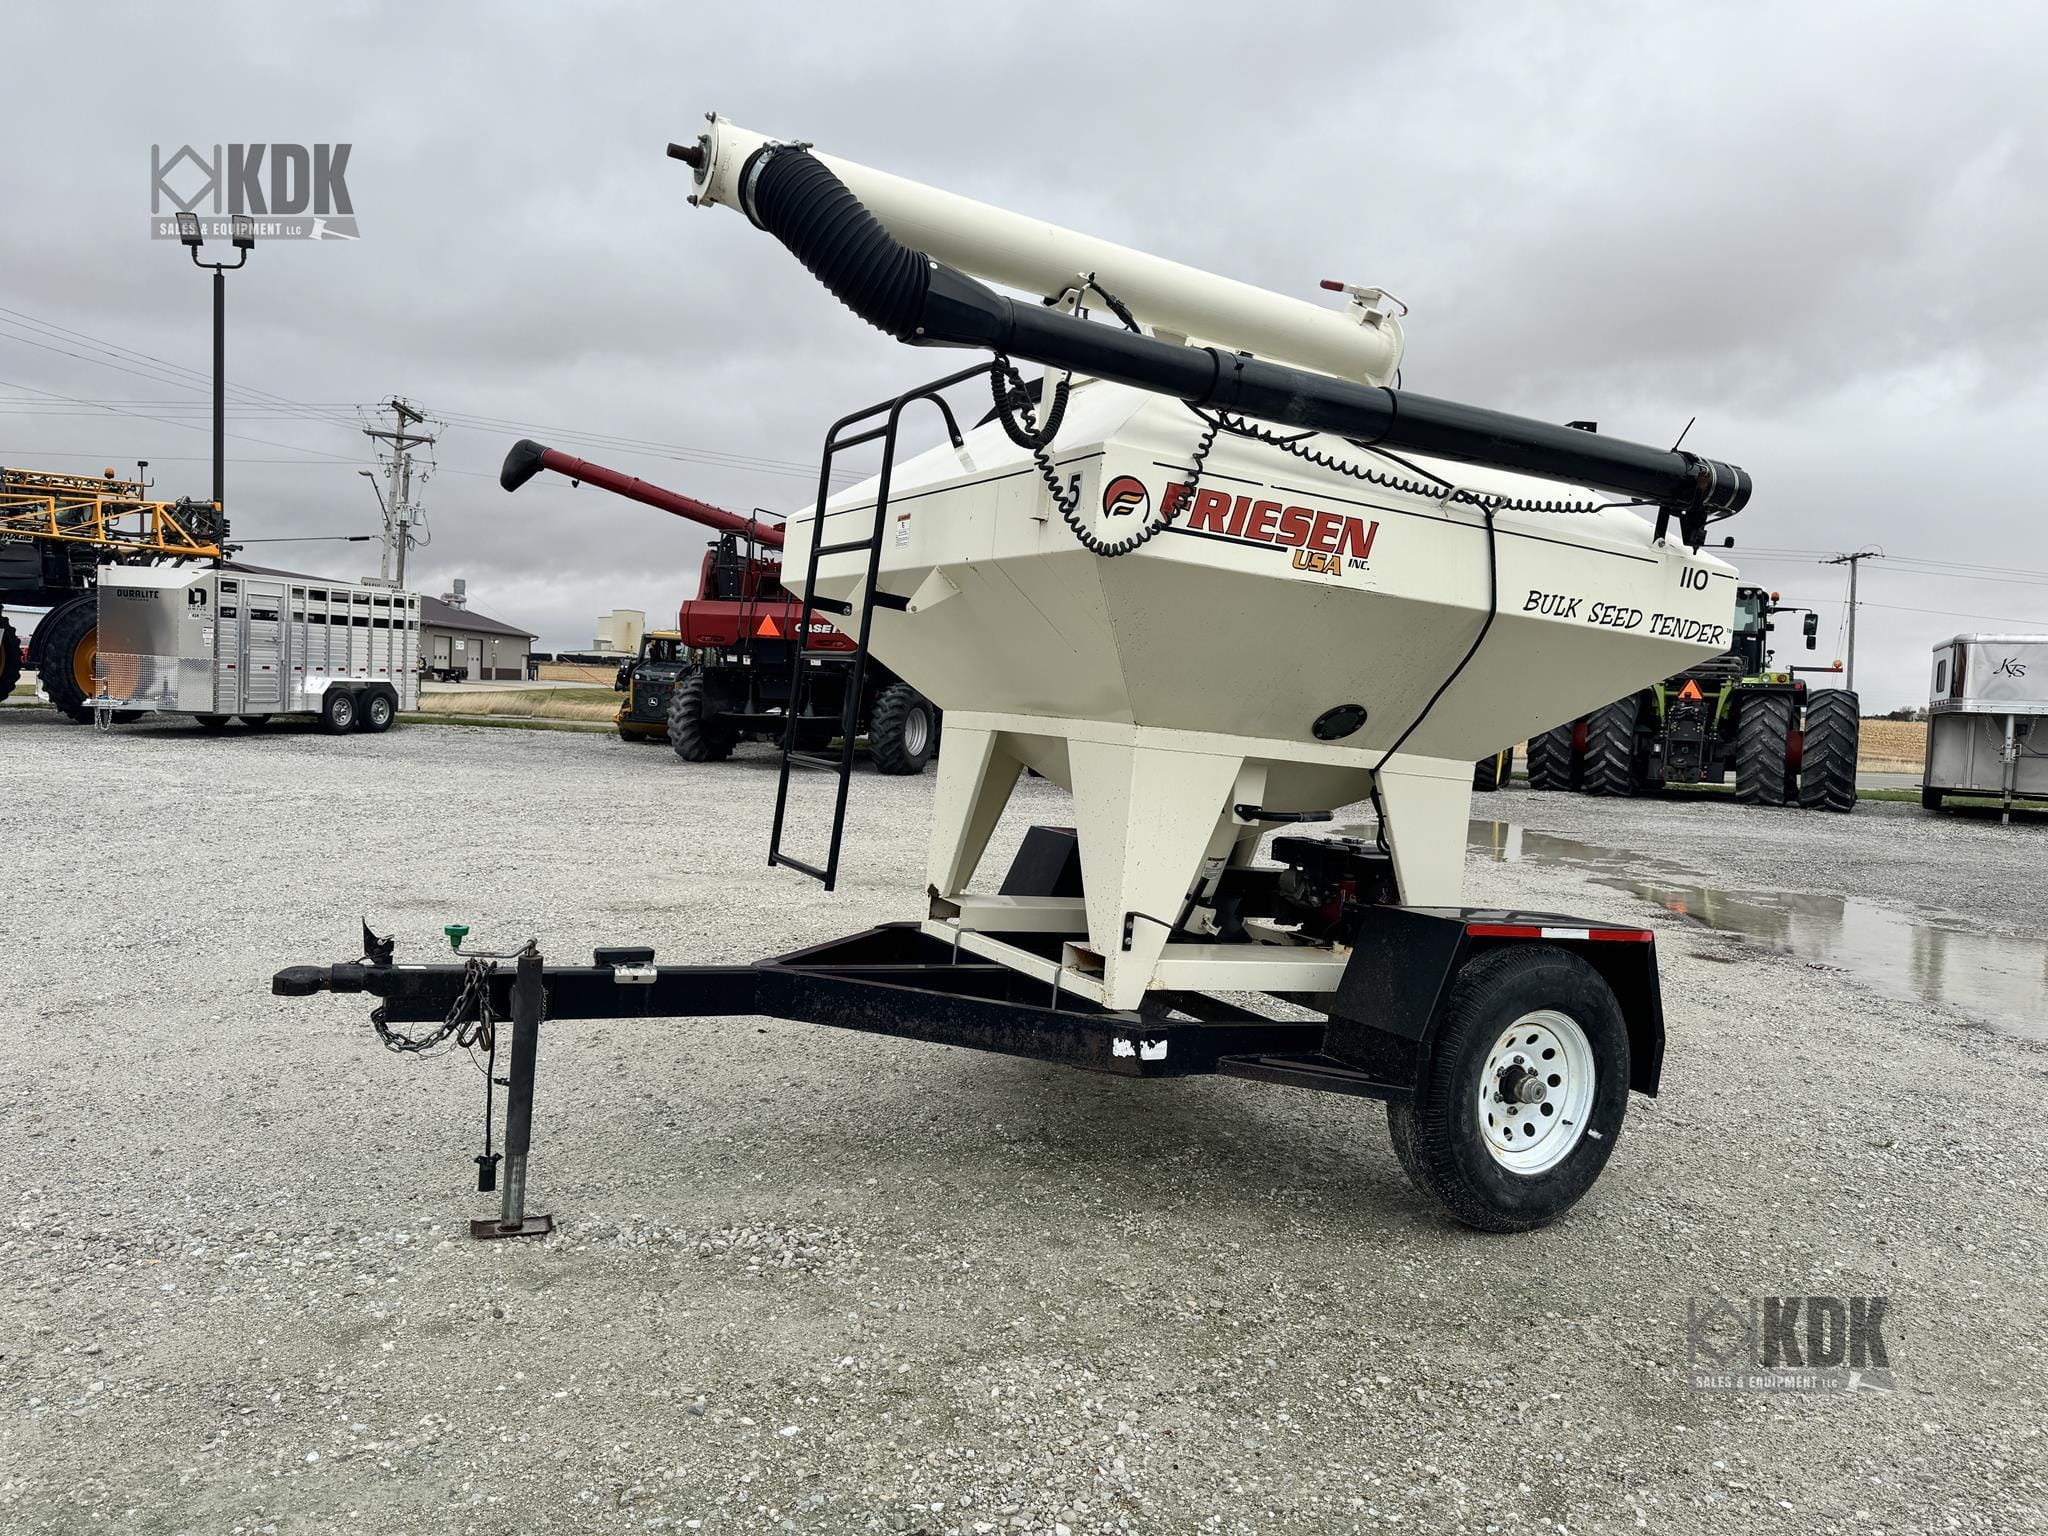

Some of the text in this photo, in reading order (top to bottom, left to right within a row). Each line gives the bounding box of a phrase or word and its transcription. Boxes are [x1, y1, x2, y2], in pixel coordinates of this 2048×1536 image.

[1068, 474, 1080, 508] 5
[1160, 482, 1379, 558] FRIESEN
[1292, 550, 1370, 576] USA INC.
[1680, 566, 1708, 590] 110
[117, 589, 159, 599] DURALITE
[1523, 590, 1583, 618] BULK
[1588, 602, 1643, 629] SEED
[1650, 613, 1724, 644] TENDER
